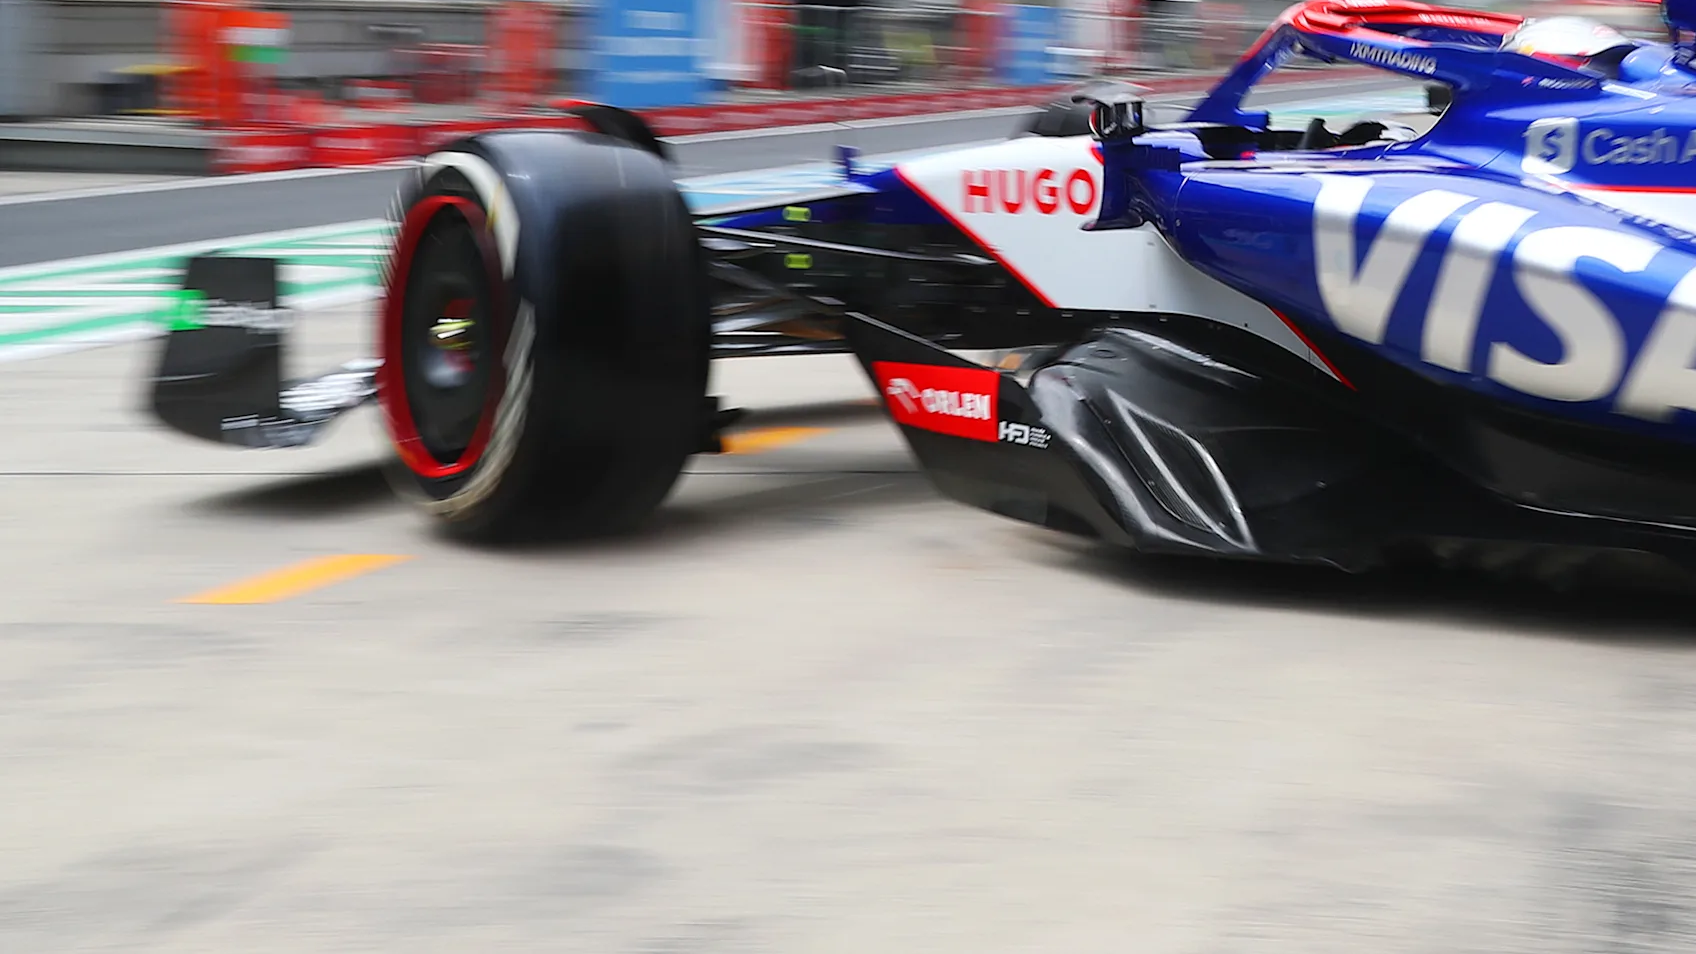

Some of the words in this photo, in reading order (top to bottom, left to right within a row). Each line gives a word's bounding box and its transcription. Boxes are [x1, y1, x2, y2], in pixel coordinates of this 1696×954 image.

[1582, 127, 1679, 165] Cash
[961, 167, 1097, 215] HUGO
[919, 387, 991, 420] ORLEN
